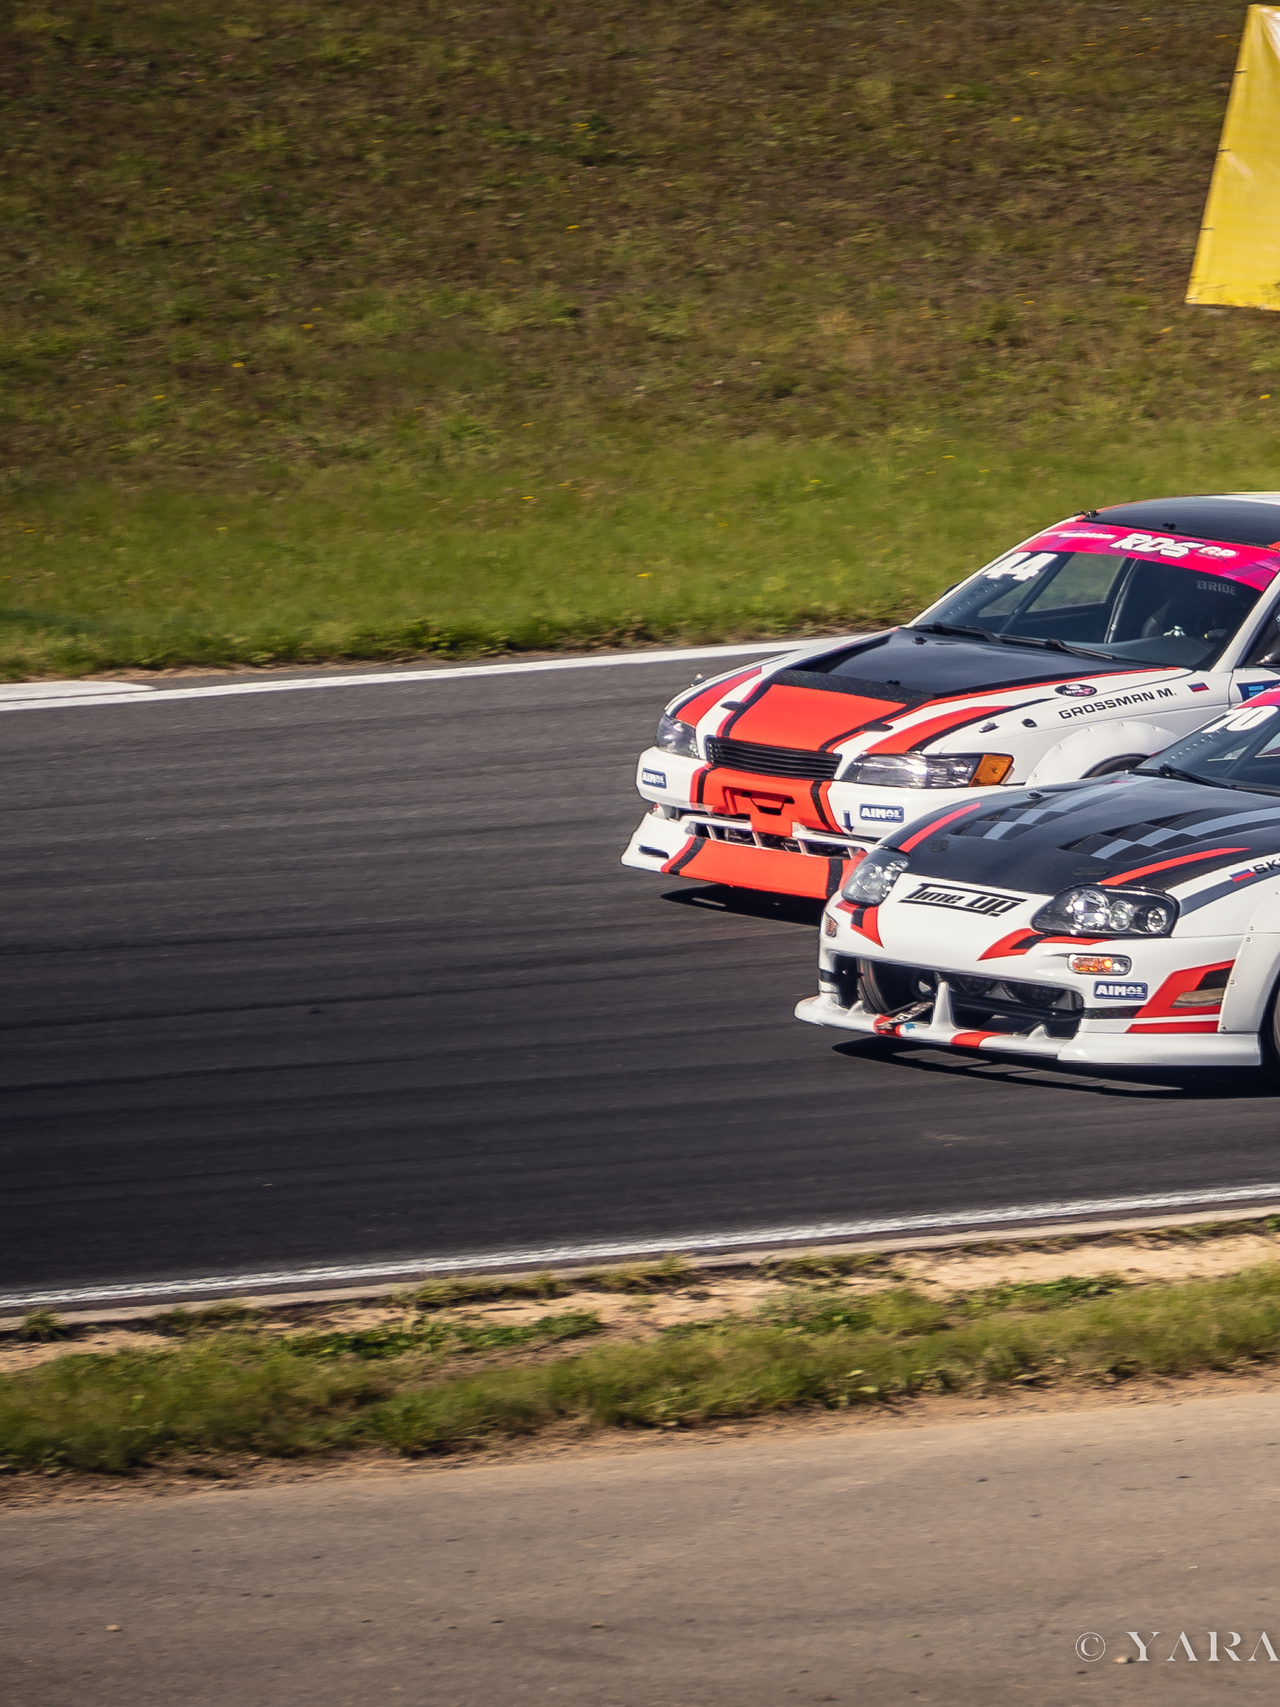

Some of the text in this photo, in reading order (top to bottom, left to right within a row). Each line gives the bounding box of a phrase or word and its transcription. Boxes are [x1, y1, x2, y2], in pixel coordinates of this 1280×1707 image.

[1109, 533, 1205, 558] RDS
[981, 551, 1059, 582] 44
[1196, 580, 1236, 596] BRIDE
[1058, 687, 1177, 719] GROSSMAN M.
